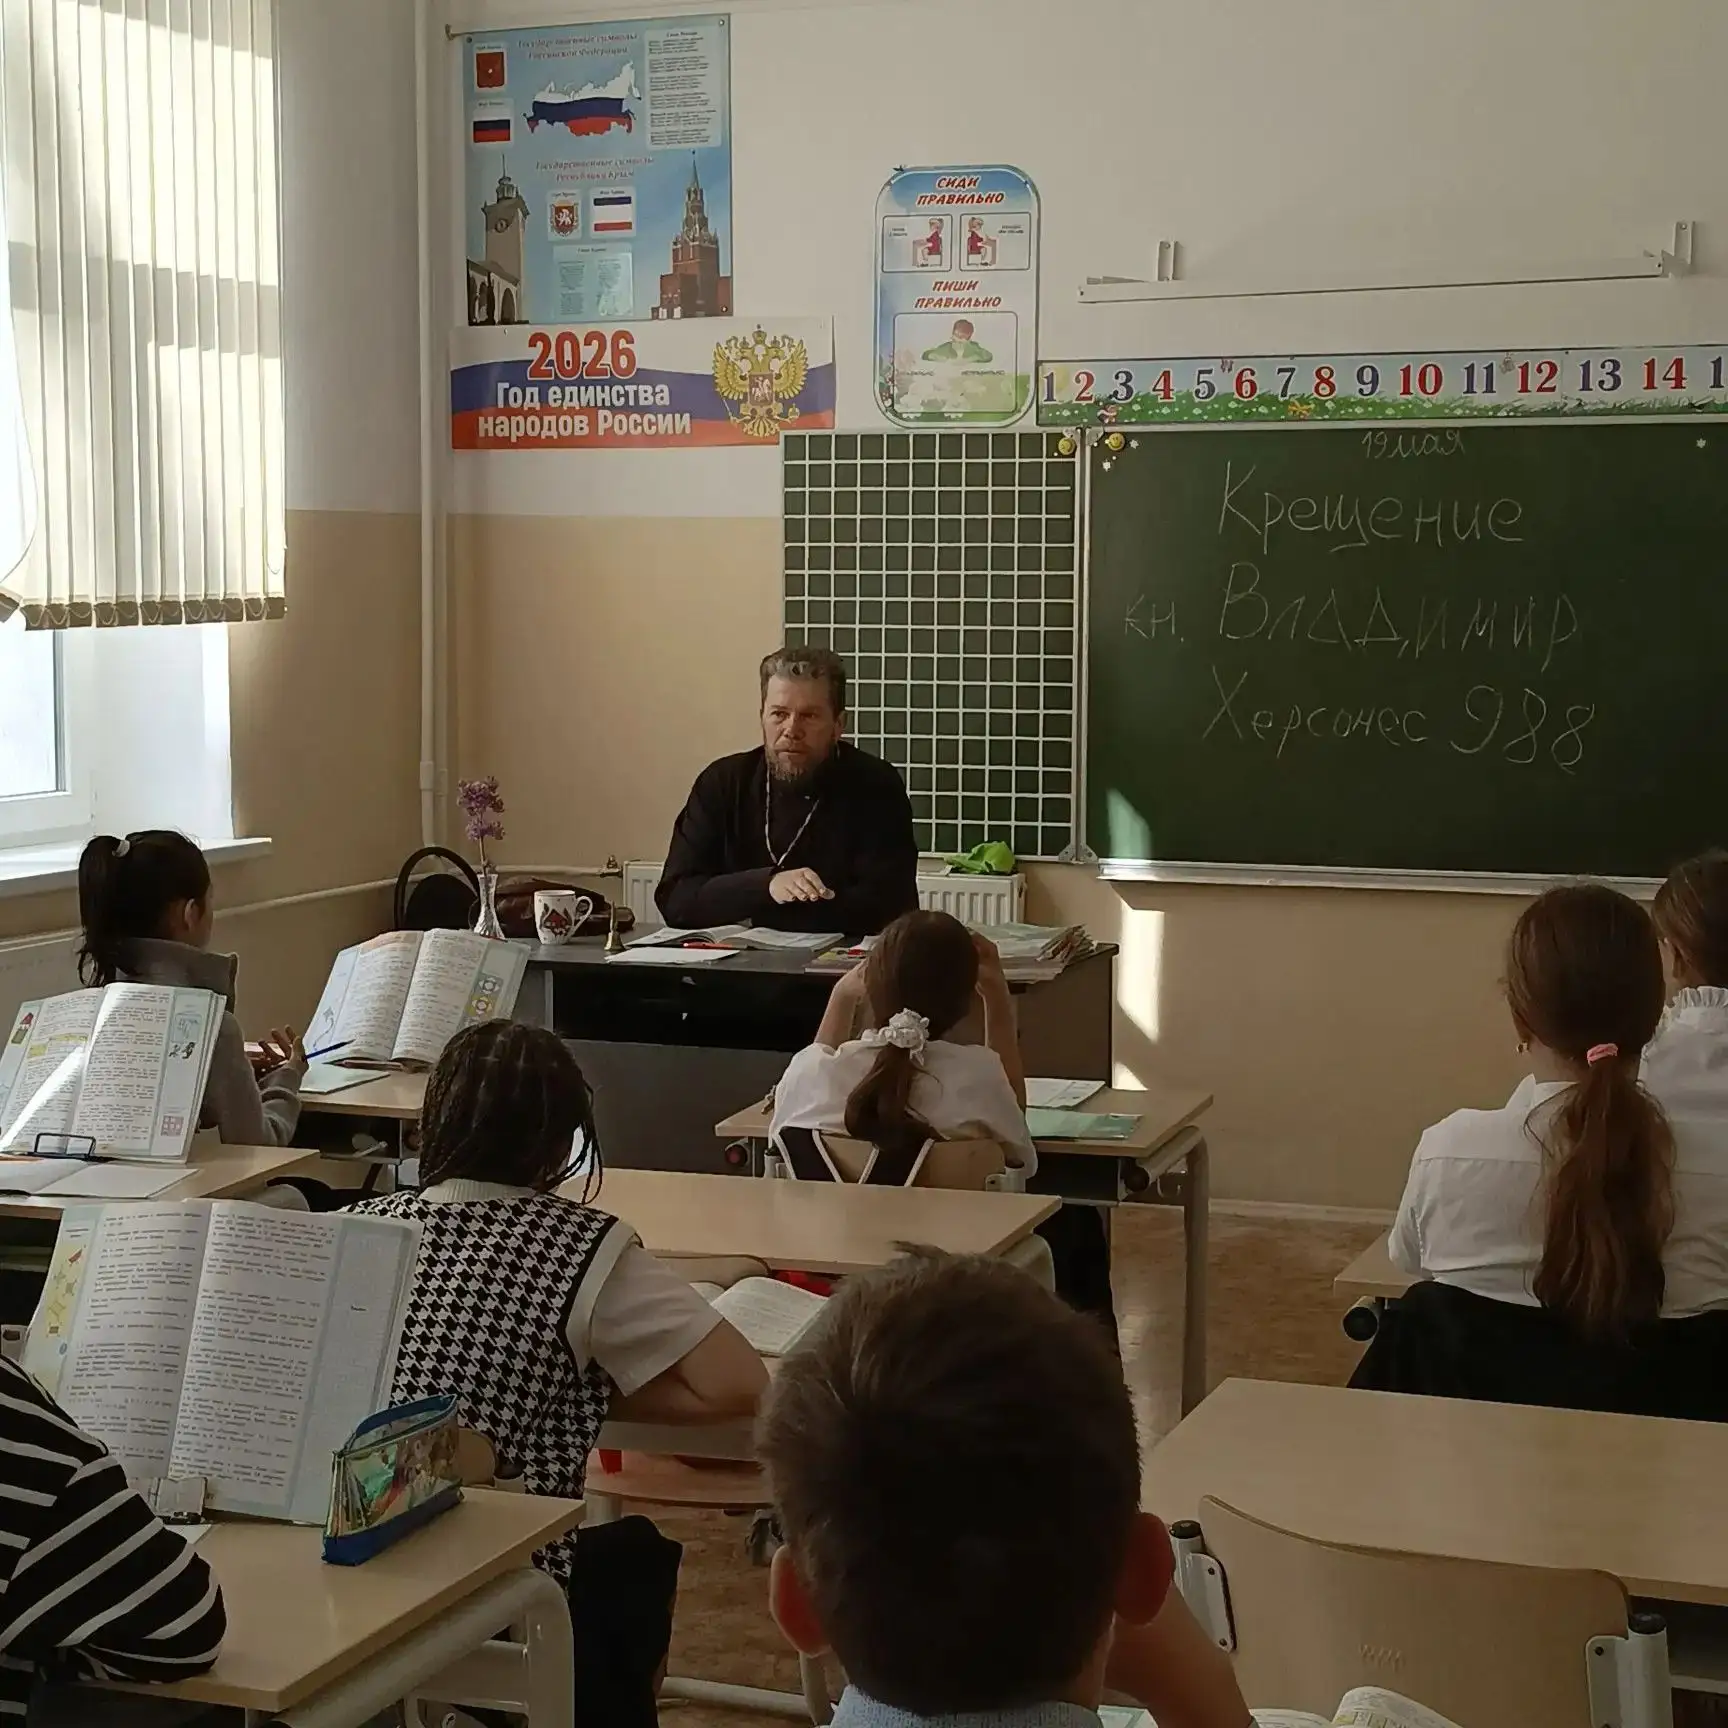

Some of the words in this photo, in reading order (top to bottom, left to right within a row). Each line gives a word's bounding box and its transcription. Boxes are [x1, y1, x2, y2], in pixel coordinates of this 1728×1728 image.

[936, 176, 980, 190] СИДИ
[916, 192, 1005, 206] ПРАВИЛЬНО
[932, 280, 979, 292] ПИШИ
[914, 297, 1002, 309] ПРАВИЛЬНО
[527, 330, 638, 381] 2026
[1043, 371, 1057, 402] 1
[1074, 371, 1095, 402] 2
[1111, 370, 1134, 401] 3
[1152, 370, 1175, 400] 4
[1194, 368, 1216, 400] 5
[1235, 368, 1258, 400] 6
[1276, 366, 1296, 398] 7
[1313, 366, 1336, 398] 8
[1356, 364, 1380, 397] 9
[1399, 363, 1444, 396] 10
[1463, 362, 1497, 395] 11
[1516, 359, 1559, 394] 12
[1578, 358, 1623, 392] 13
[1641, 356, 1688, 391] 14
[497, 382, 544, 410] Год
[548, 381, 671, 409] единства
[478, 411, 589, 443] народов
[597, 409, 692, 437] России
[1218, 461, 1524, 555] Крещение
[1202, 664, 1429, 760] Херсонес
[1450, 685, 1596, 776] 988
